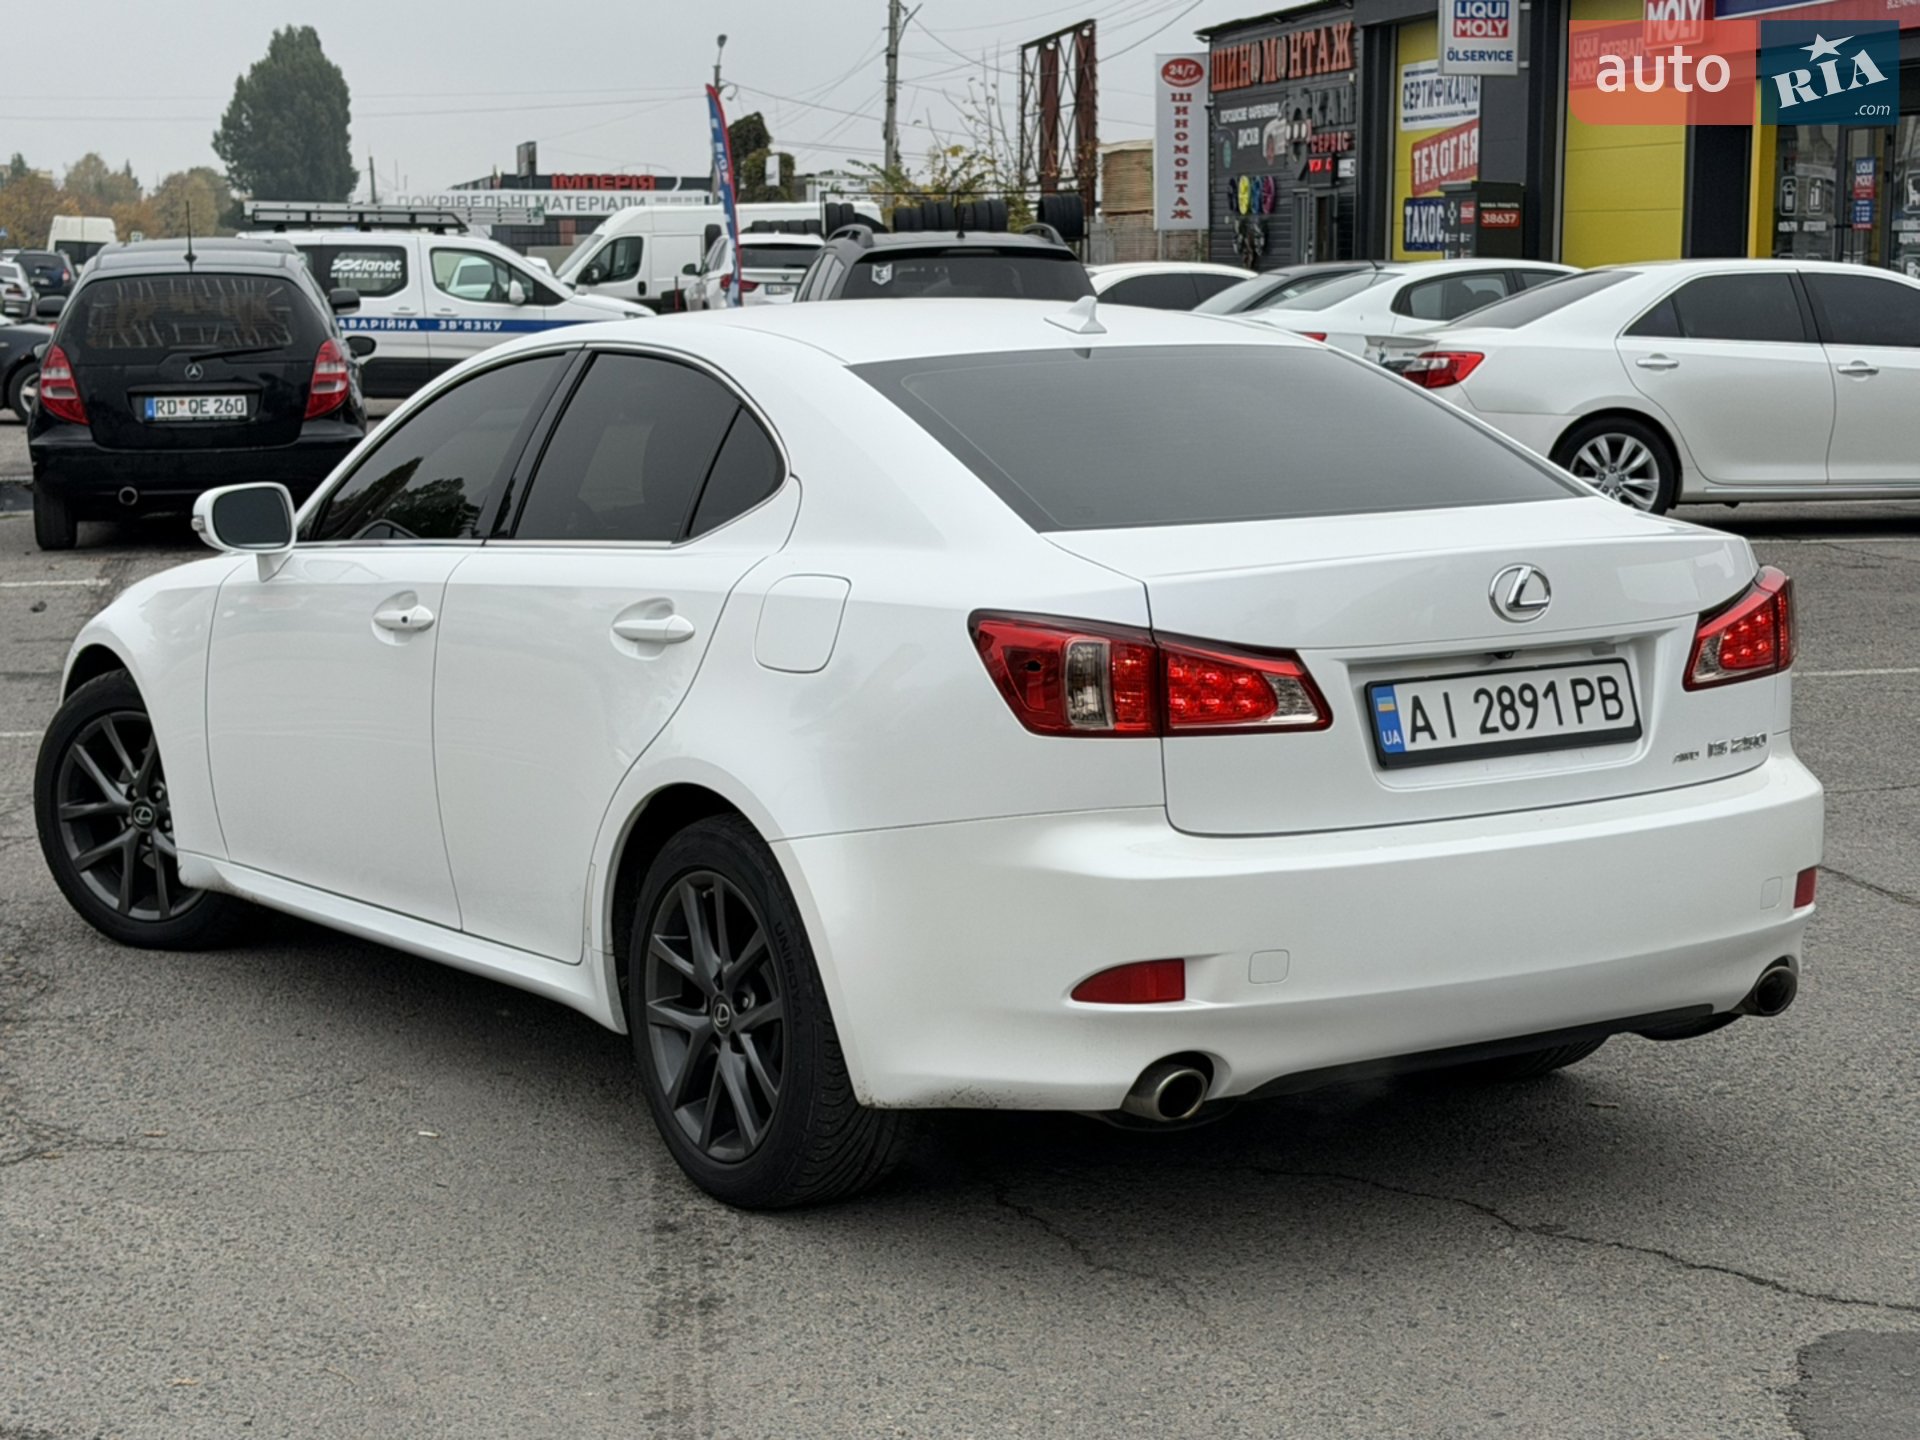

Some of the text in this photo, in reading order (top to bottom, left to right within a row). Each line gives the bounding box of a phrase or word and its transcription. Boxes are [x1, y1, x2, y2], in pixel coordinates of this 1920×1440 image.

[1456, 1, 1507, 18] LIQUI
[1456, 20, 1507, 36] MOLY
[1646, 0, 1701, 43] MOLY
[1210, 20, 1354, 93] ШИНОМОНТАЖ
[1446, 46, 1514, 62] ÖLSERVICE
[1168, 64, 1197, 78] 24/7
[551, 173, 656, 190] ІМПЕРІЯ
[535, 195, 646, 212] МАТЕРІАЛИ
[338, 318, 503, 330] АВАРІЙНА ЗВ'ЯЗКУ
[156, 400, 178, 415] RD
[214, 398, 244, 413] 260
[1409, 675, 1625, 744] AI 2891 PB
[1383, 730, 1402, 746] UA
